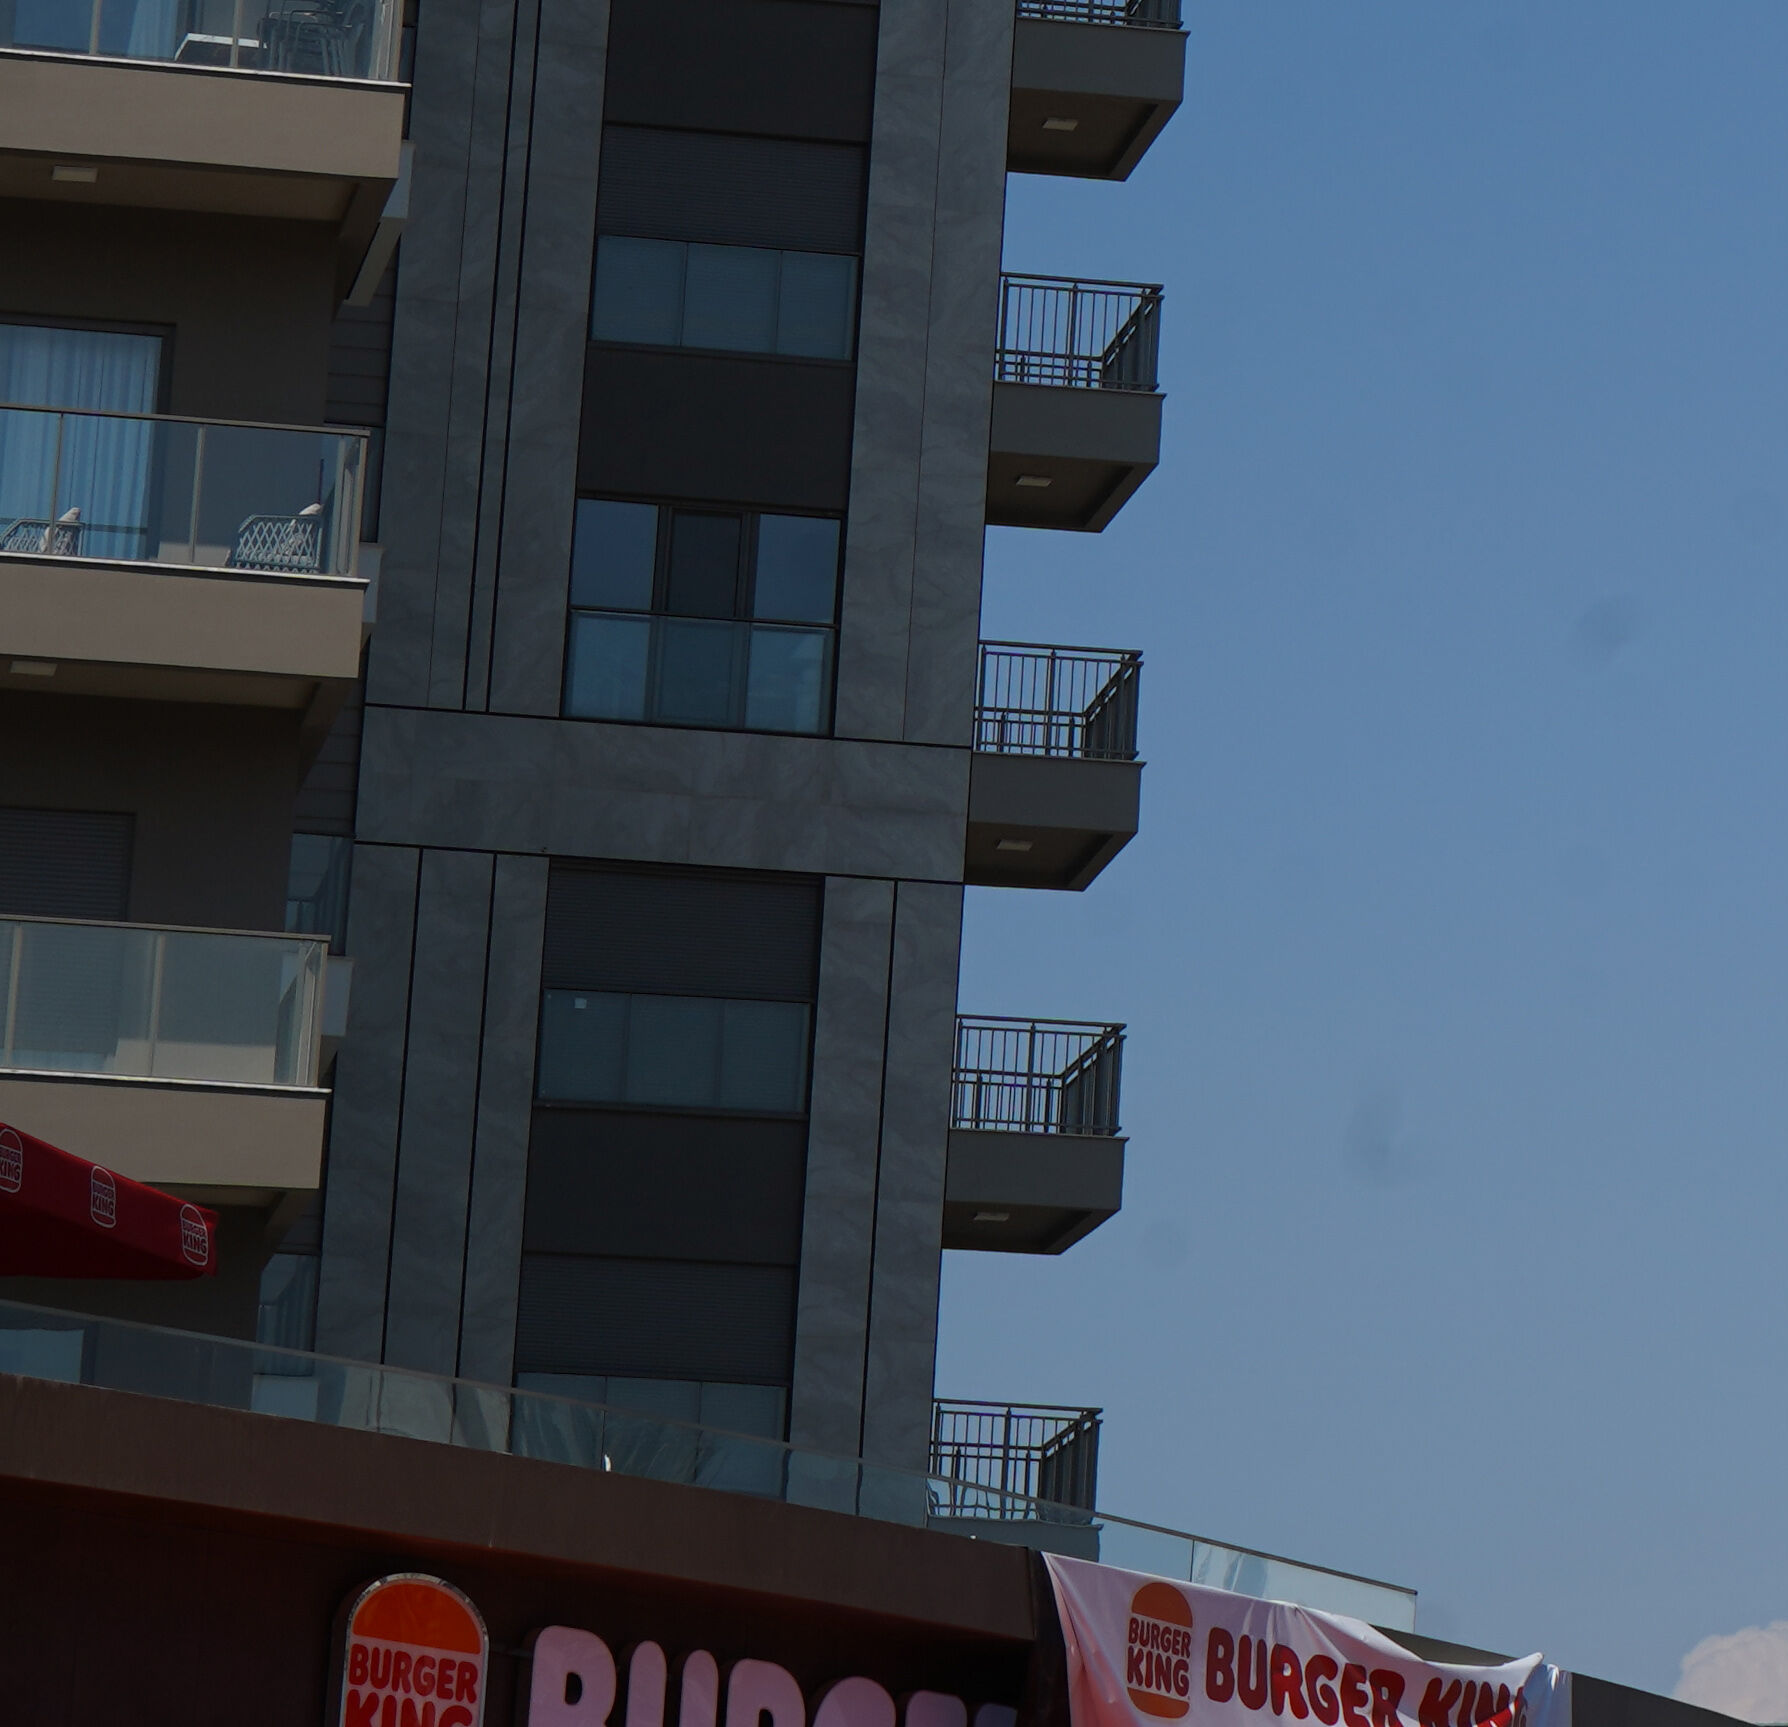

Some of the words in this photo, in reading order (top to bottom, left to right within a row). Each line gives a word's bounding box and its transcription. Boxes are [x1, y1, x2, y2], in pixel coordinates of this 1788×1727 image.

[93, 1195, 114, 1216] KING
[183, 1233, 207, 1254] KING
[1128, 1617, 1192, 1659] BURGER
[349, 1643, 479, 1704] BURGER
[1127, 1645, 1190, 1698] KING
[1205, 1626, 1406, 1727] BURGER
